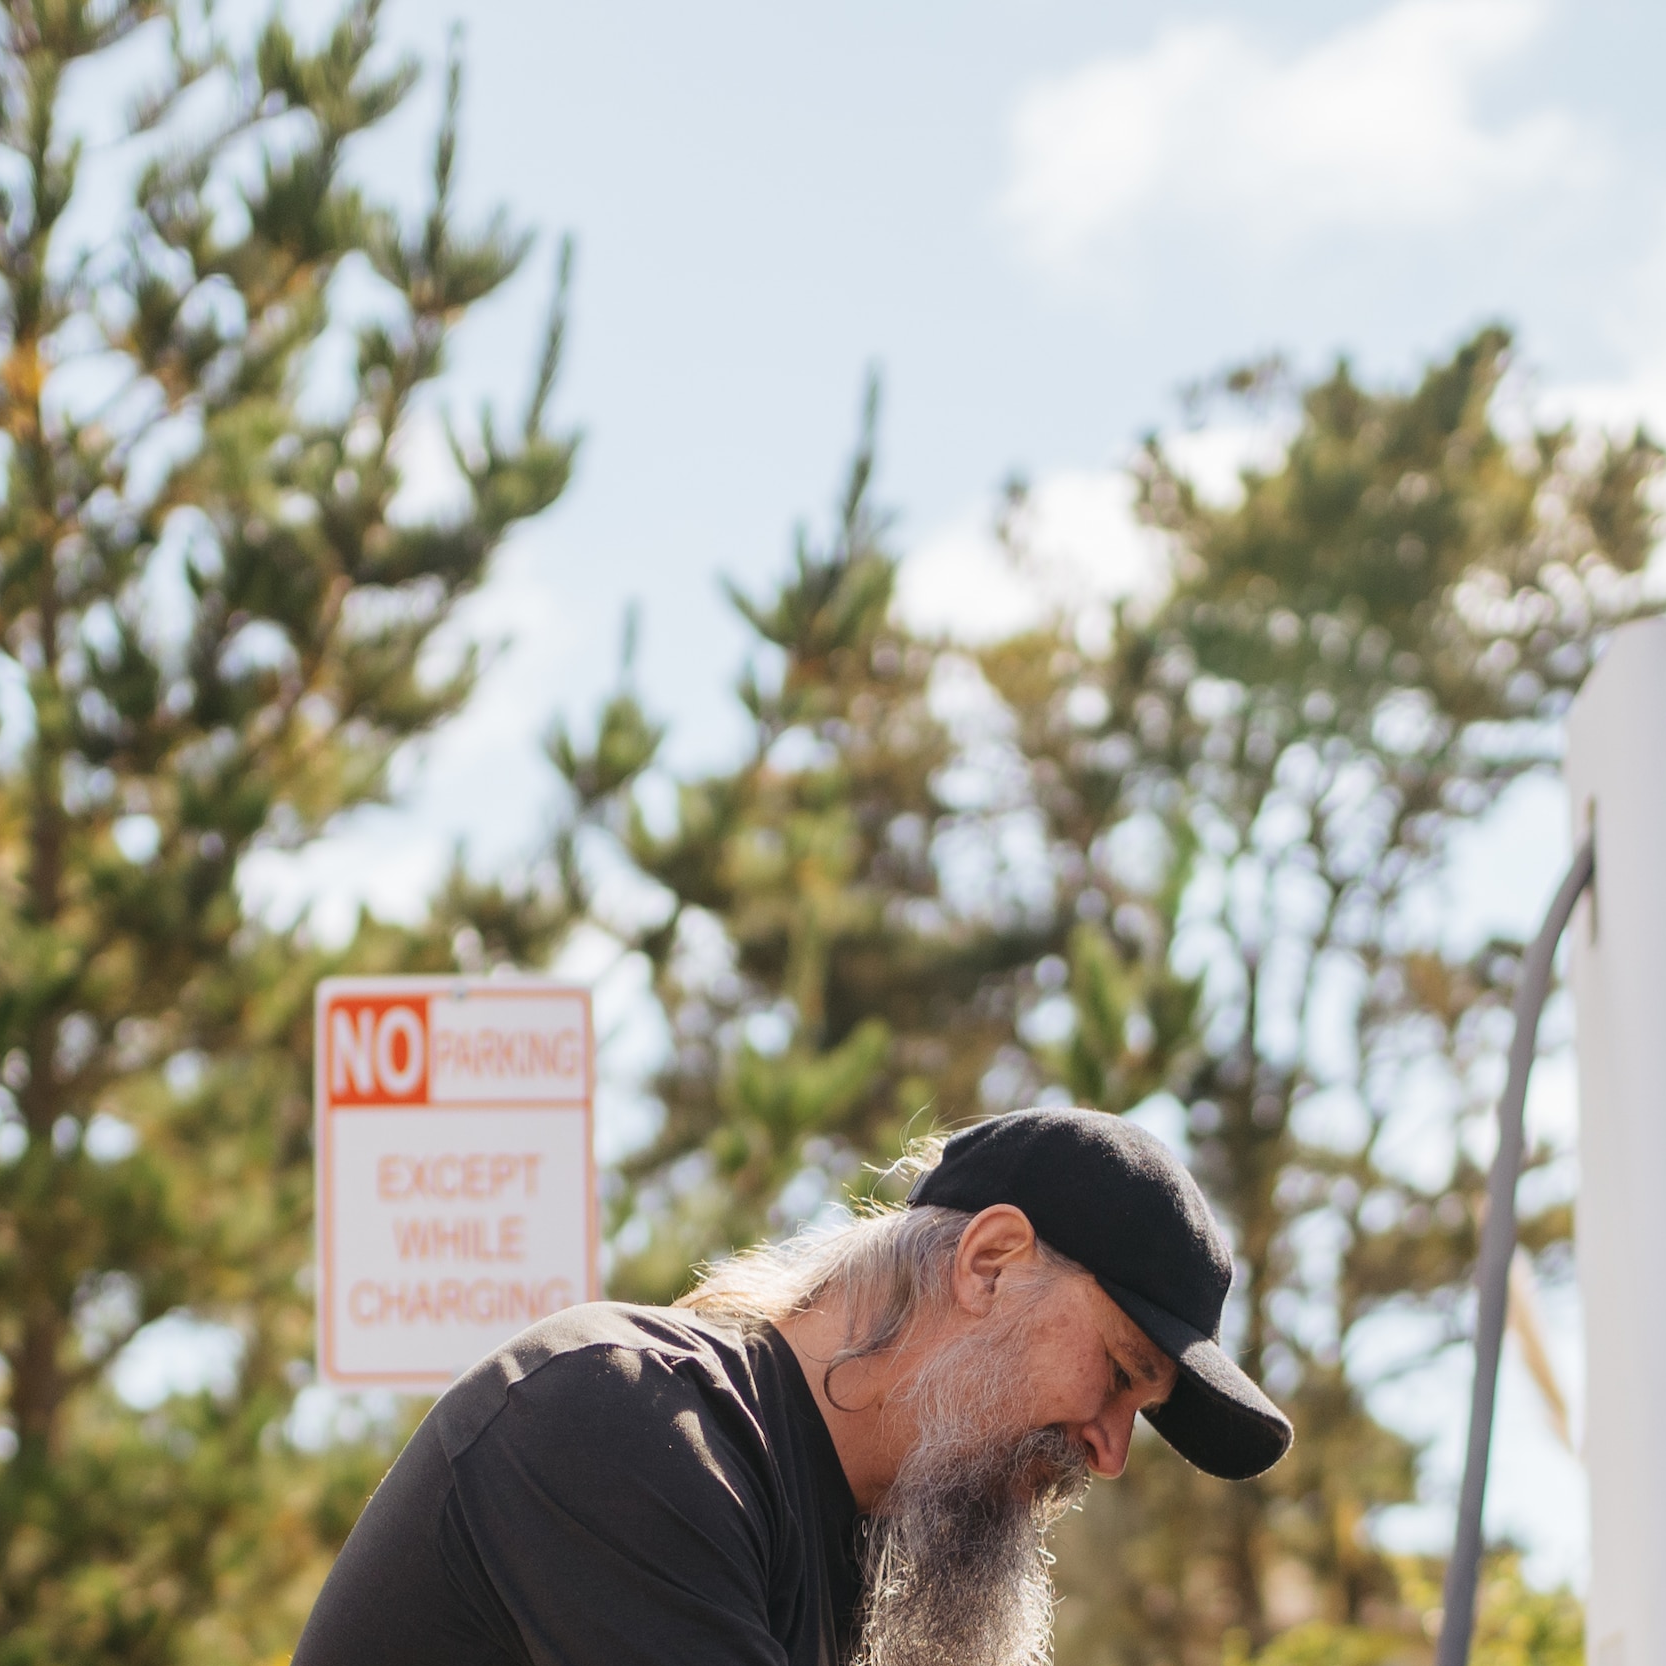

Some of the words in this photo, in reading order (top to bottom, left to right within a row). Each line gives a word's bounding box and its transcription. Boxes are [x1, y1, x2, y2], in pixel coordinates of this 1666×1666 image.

[334, 1004, 425, 1096] NO
[434, 1029, 579, 1079] PARKING
[375, 1151, 545, 1201] EXCEPT
[391, 1214, 527, 1263] WHILE
